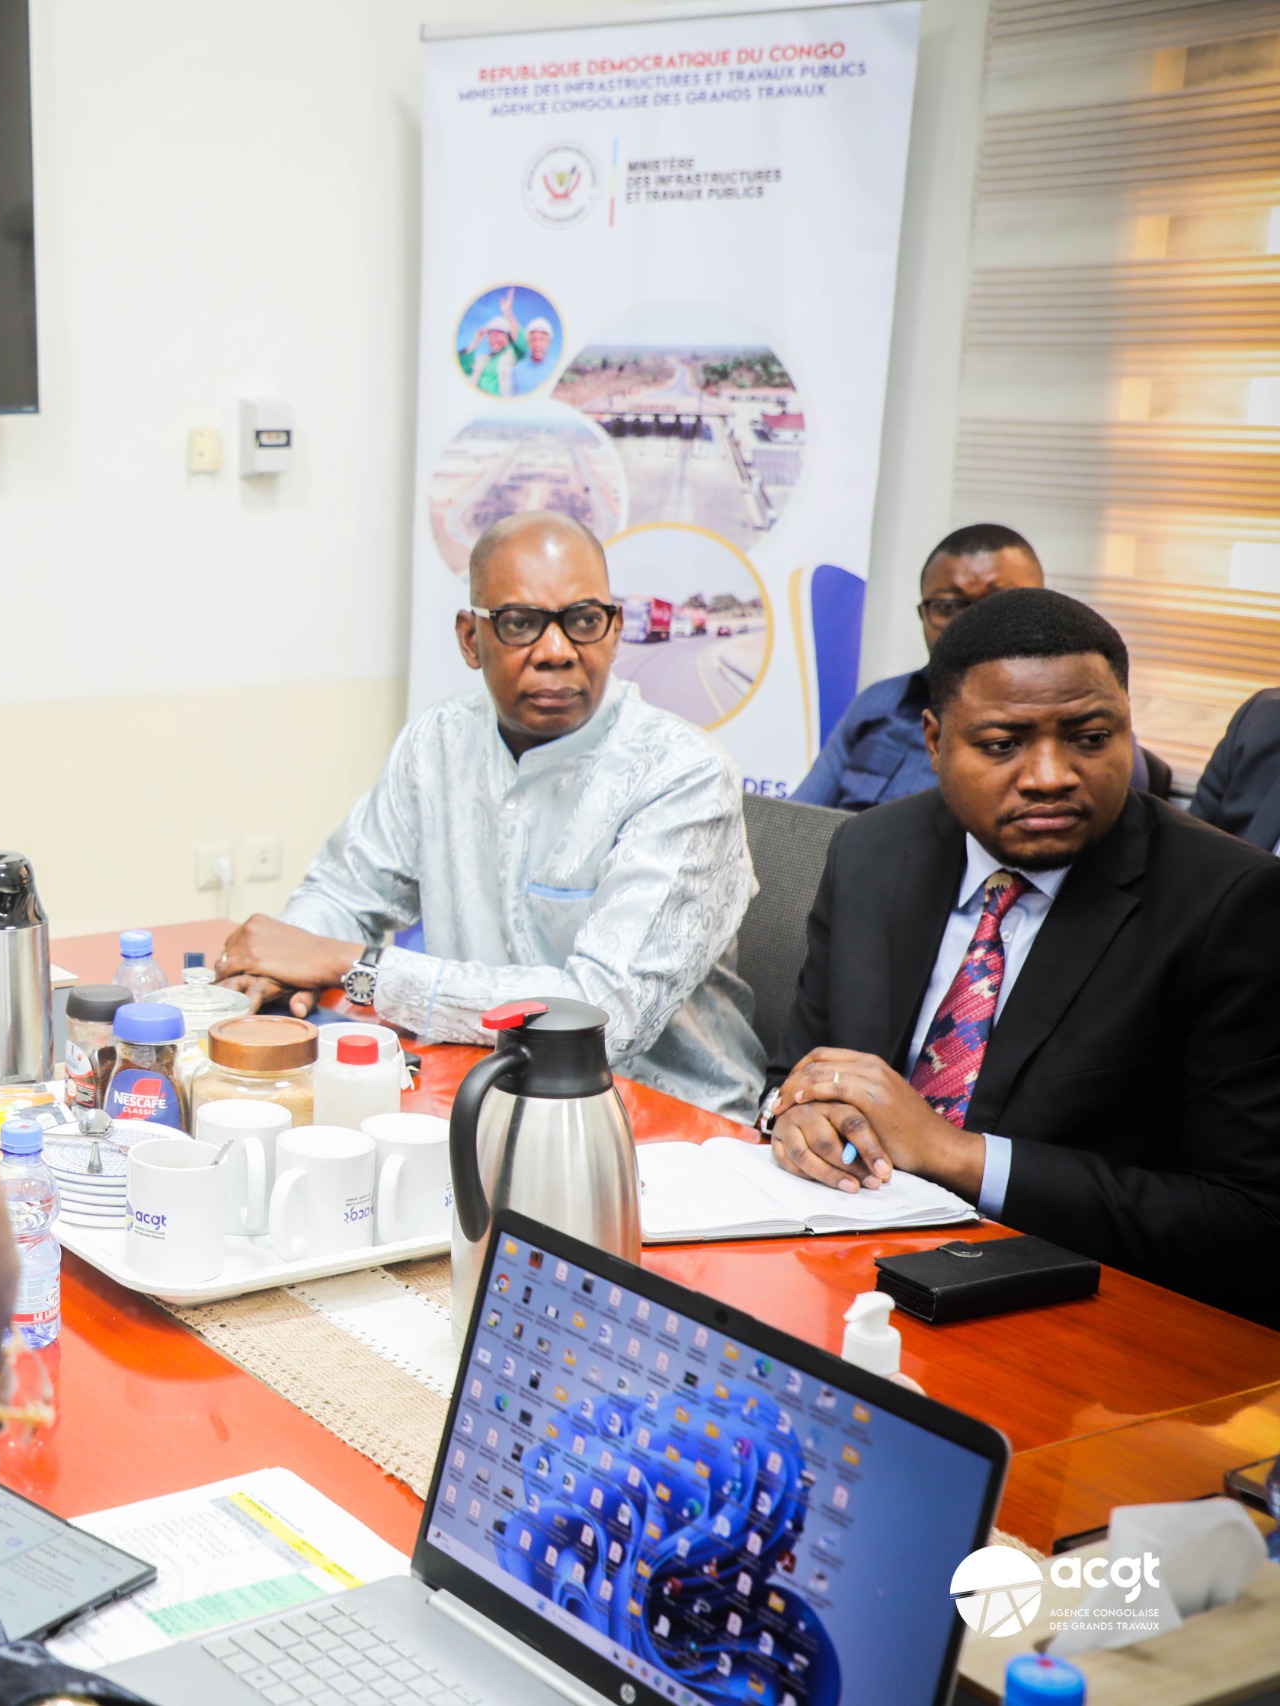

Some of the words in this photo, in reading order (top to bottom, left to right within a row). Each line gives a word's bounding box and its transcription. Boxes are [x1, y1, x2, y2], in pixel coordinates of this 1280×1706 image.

[587, 49, 731, 76] DEMOCRATIQUE
[736, 47, 763, 65] DU
[769, 41, 846, 62] CONGO
[534, 82, 560, 97] DES
[705, 72, 722, 86] ET
[729, 67, 795, 83] TRAVAUX
[800, 62, 867, 79] PUBLICS
[490, 102, 547, 117] AGENCE
[653, 91, 681, 107] DES
[686, 88, 752, 105] GRANDS
[758, 84, 826, 100] TRAVAUX
[626, 175, 650, 190] DES
[626, 190, 641, 204] ET
[707, 185, 764, 201] PUBLICS
[743, 778, 787, 800] DES
[122, 1106, 157, 1116] CLASSIC
[135, 1210, 167, 1231] acgt
